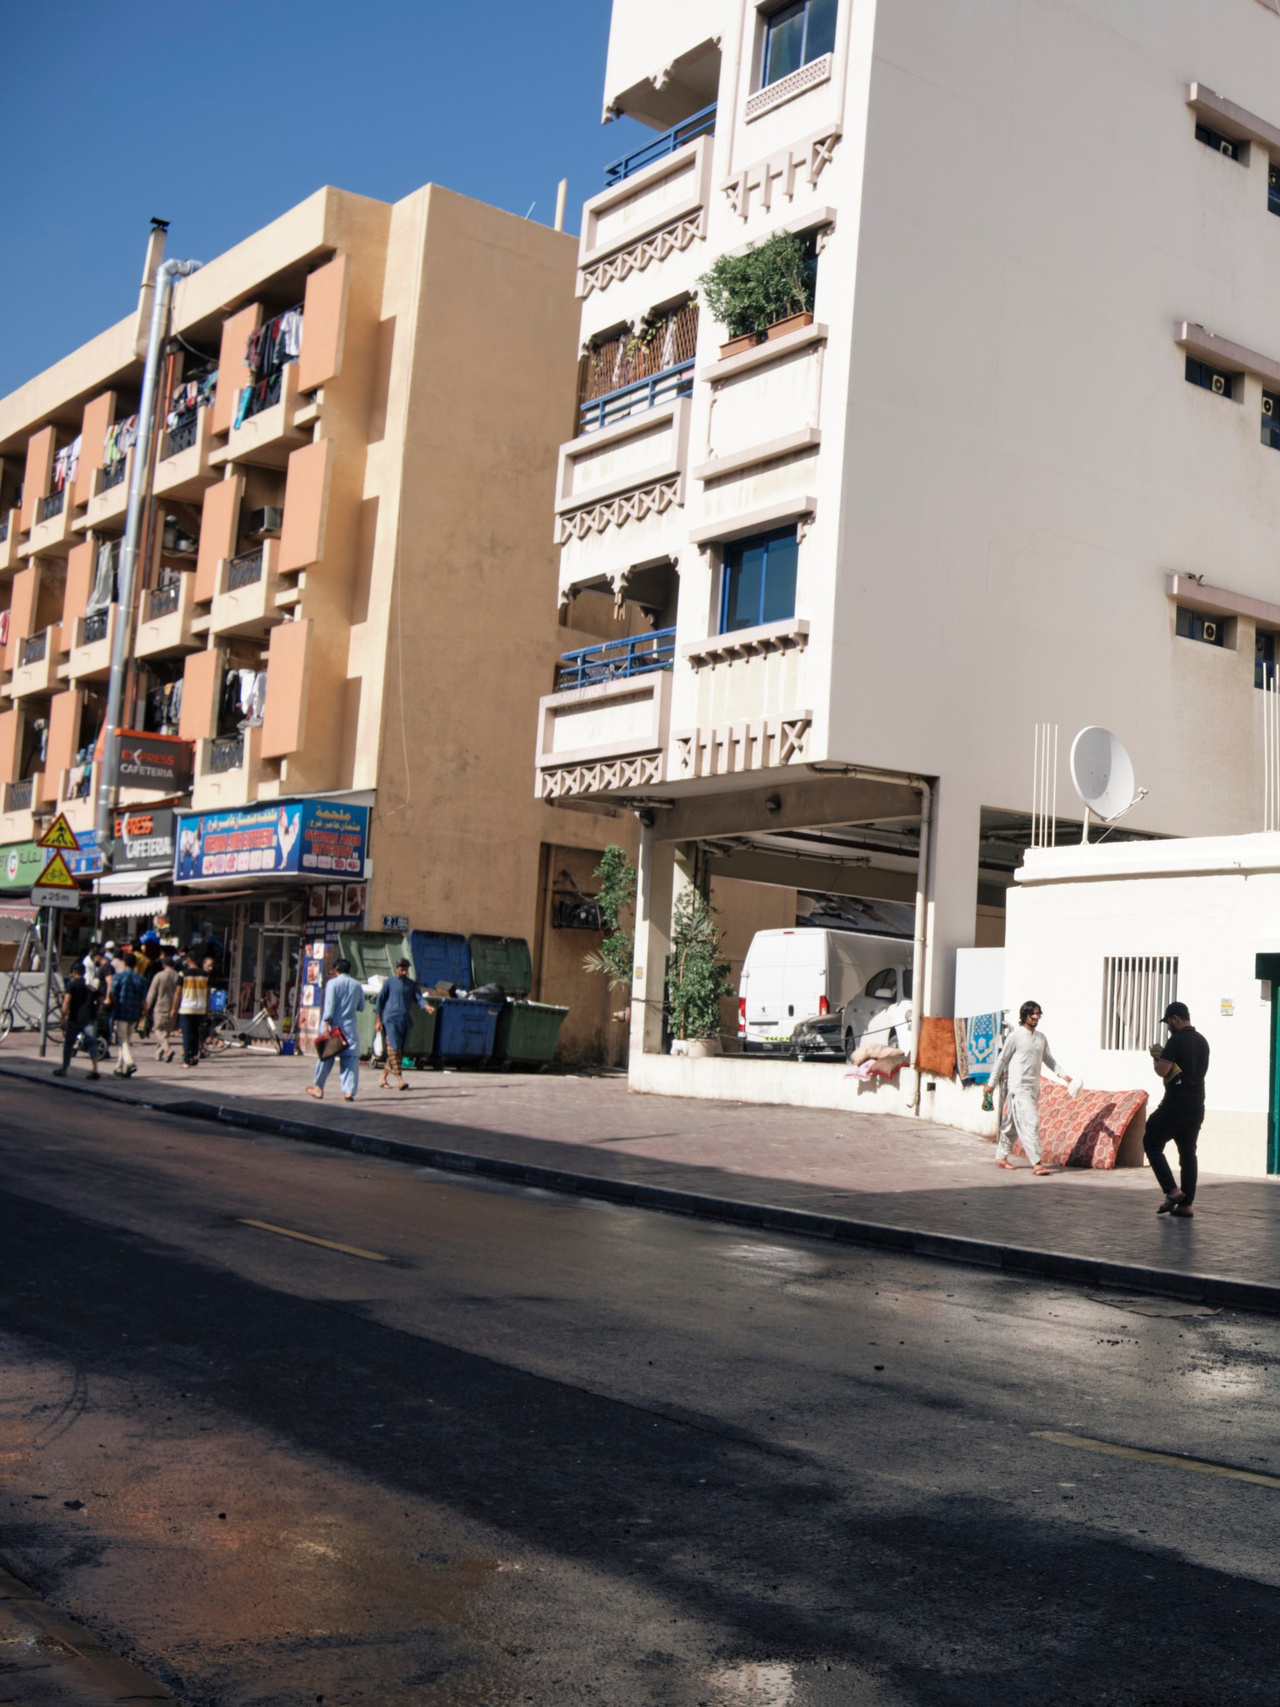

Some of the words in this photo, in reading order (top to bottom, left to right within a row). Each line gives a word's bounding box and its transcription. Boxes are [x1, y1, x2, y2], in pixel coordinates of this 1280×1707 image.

[121, 749, 176, 766] EXPRESS
[120, 763, 174, 779] CAFETERIA
[114, 814, 154, 838] EXPRESS
[304, 830, 339, 845] OTHMAN
[340, 833, 362, 847] AMER
[126, 836, 172, 859] CAFETERIA
[311, 843, 354, 858] BUTCHERY
